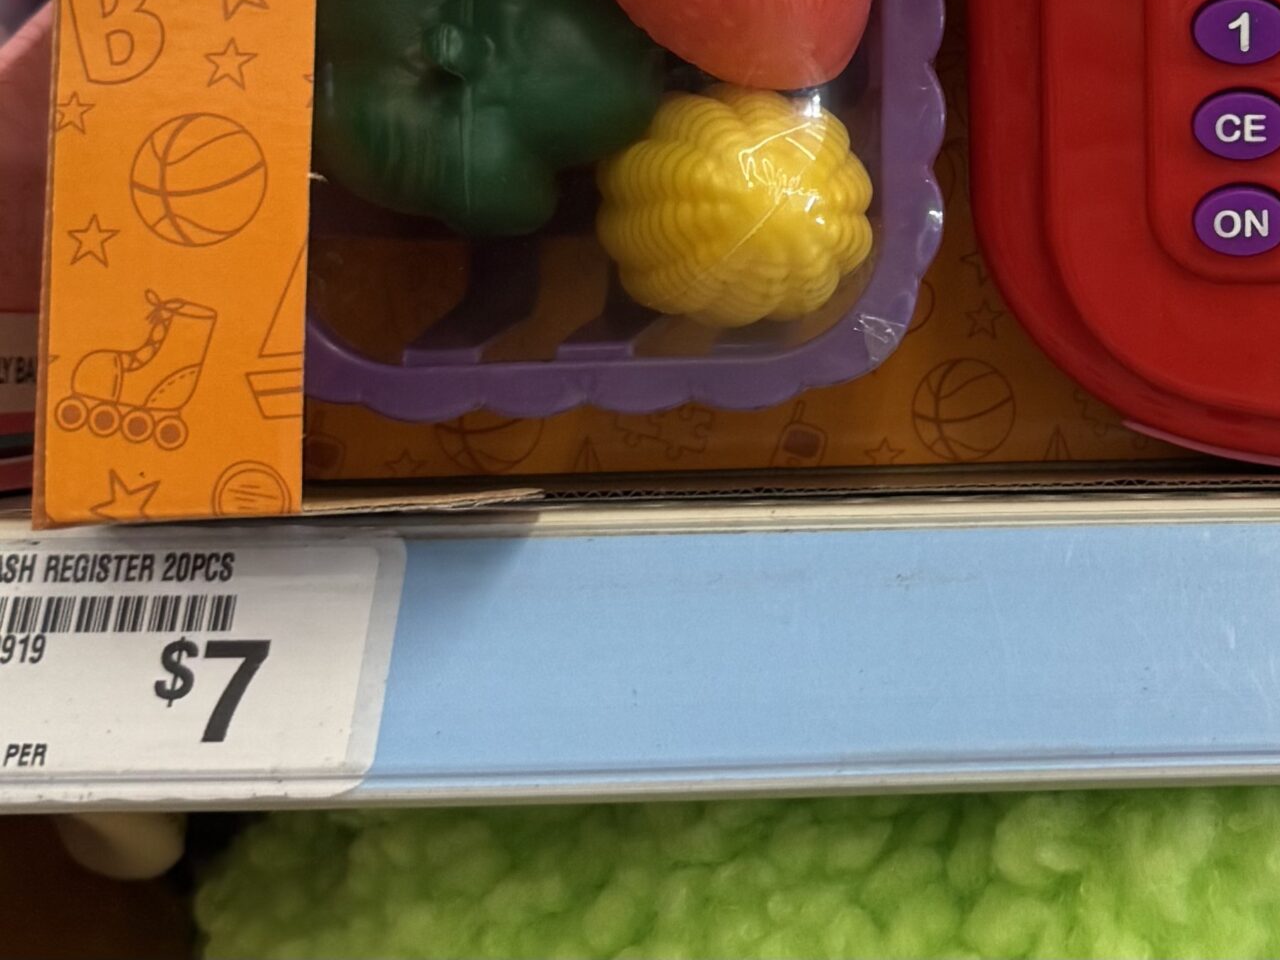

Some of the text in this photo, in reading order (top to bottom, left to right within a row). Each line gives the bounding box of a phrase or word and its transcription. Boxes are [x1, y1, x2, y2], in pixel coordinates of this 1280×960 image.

[1228, 11, 1251, 53] 1
[1215, 113, 1267, 143] CE
[1213, 209, 1270, 238] ON
[43, 553, 155, 583] REGISTER
[161, 552, 235, 582] 20PCS
[3, 743, 47, 766] PER
